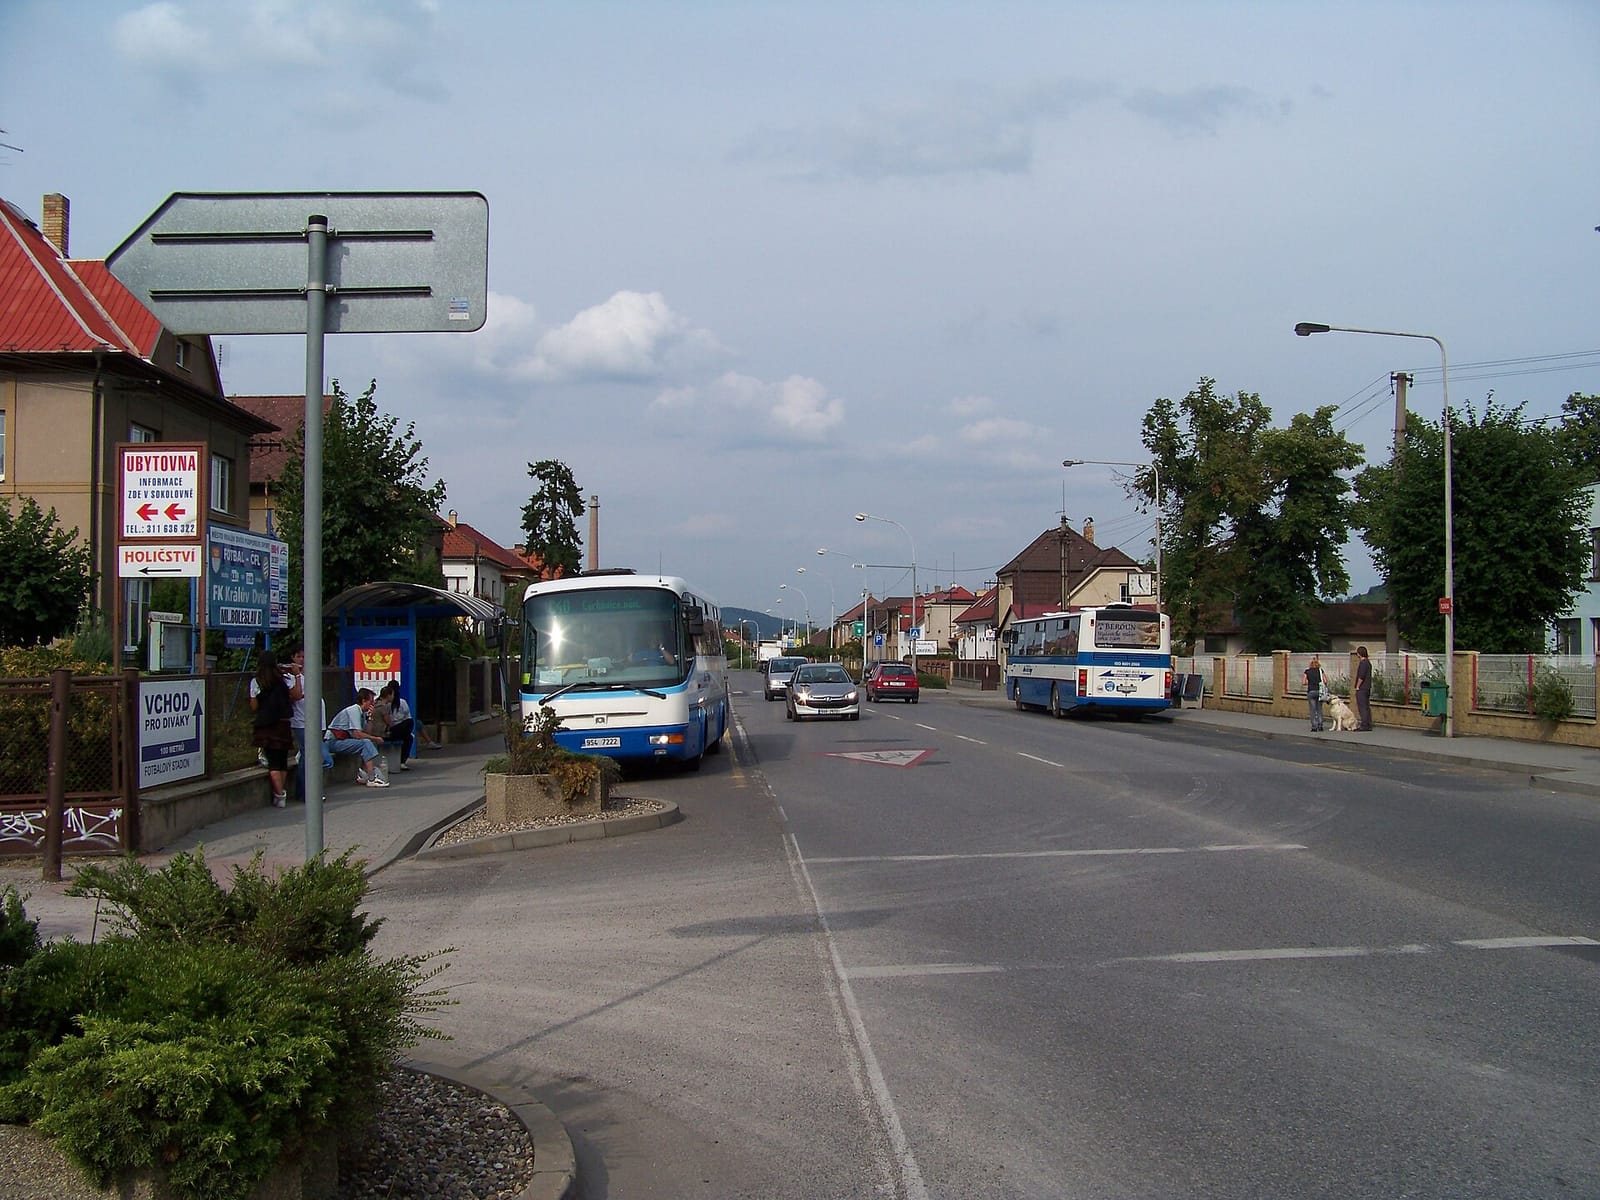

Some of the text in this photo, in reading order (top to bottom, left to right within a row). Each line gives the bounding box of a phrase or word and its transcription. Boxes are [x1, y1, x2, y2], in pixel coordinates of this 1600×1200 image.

[126, 455, 196, 472] UBYTOVNA
[139, 477, 183, 487] INFORMACE
[128, 490, 141, 499] ZDE
[144, 490, 149, 499] V
[126, 524, 195, 534] TEL.: 311 636 322
[124, 548, 195, 564] HOLIČSTVÍ
[223, 547, 245, 563] FOTBAL
[213, 584, 224, 601] FK
[224, 586, 250, 603] Králův
[144, 692, 190, 715] VCHOD
[145, 714, 190, 731] PRO DIVÁKY
[601, 738, 618, 746] 7222
[144, 760, 172, 776] FOTBALOVÝ
